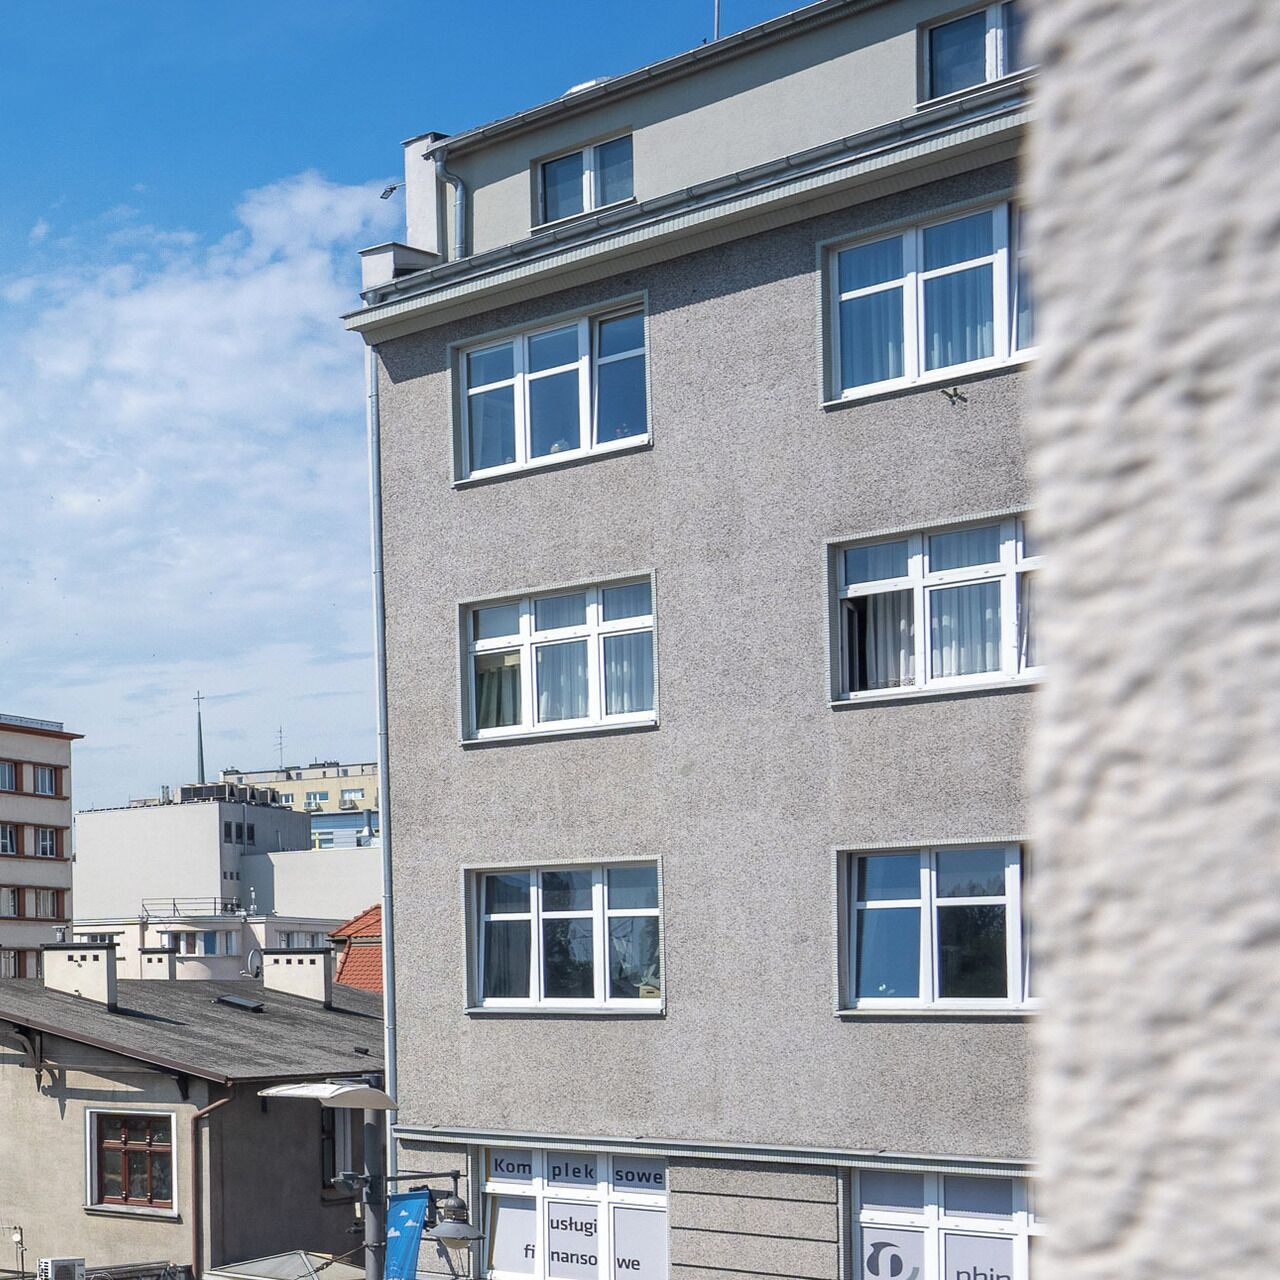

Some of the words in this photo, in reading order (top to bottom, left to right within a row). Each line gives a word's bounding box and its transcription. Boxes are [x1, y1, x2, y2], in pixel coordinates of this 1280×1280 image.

[494, 1158, 532, 1175] Kom
[552, 1162, 594, 1180] plek
[615, 1168, 663, 1184] sowe
[550, 1216, 598, 1237] usługi
[524, 1244, 536, 1259] fi
[551, 1250, 598, 1266] nanso
[617, 1256, 641, 1270] we
